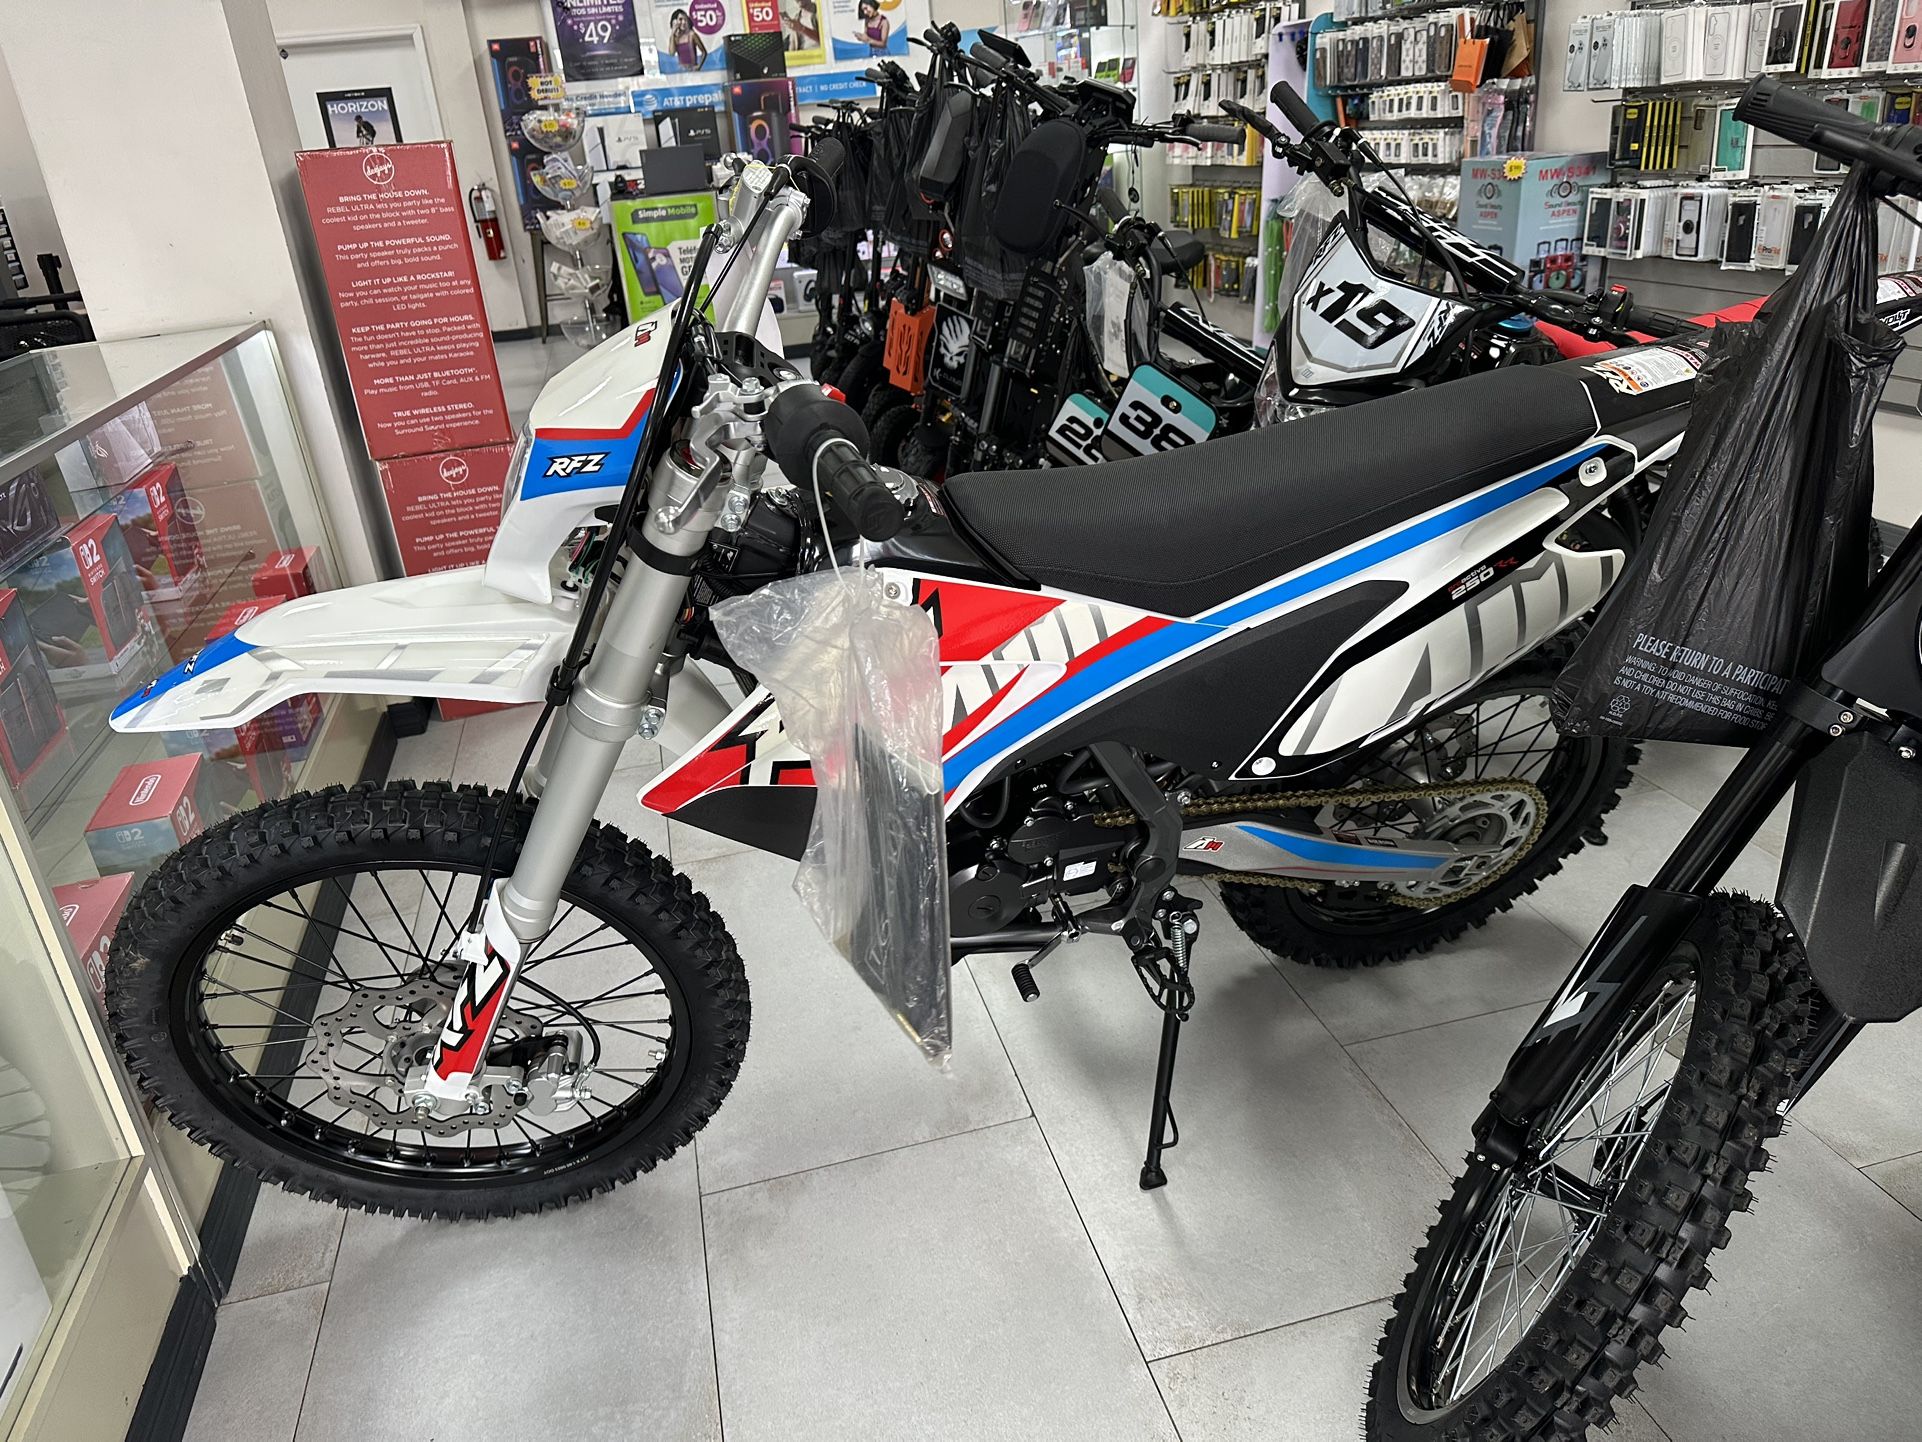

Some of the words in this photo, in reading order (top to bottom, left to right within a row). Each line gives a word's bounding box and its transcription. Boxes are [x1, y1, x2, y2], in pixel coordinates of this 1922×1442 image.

[692, 10, 717, 26] $50
[750, 8, 773, 21] $50
[579, 21, 611, 44] $49
[830, 83, 848, 91] CREDIT
[327, 100, 388, 114] HORIZON
[663, 95, 685, 106] AT&T
[378, 191, 403, 200] HOUSE
[638, 208, 666, 219] Simple
[667, 206, 696, 215] Mobile
[1551, 208, 1577, 218] ASPEN
[402, 218, 428, 226] tweeter.
[385, 237, 424, 246] POWERFUL
[426, 234, 451, 242] SOUND.
[392, 275, 408, 283] LIKE
[416, 271, 454, 280] ROCKSTAR!
[449, 314, 474, 322] HOURS.
[374, 377, 393, 385] MORE
[412, 406, 445, 415] WIRELESS
[447, 402, 473, 410] STEREO.
[544, 452, 610, 478] RFZ
[1451, 567, 1494, 600] 250
[1632, 633, 1673, 658] PLEASE
[1669, 646, 1710, 670] RTURN
[1708, 656, 1724, 674] TO
[1721, 662, 1733, 678] A
[1658, 665, 1668, 676] TO
[1685, 674, 1712, 689] DANGER
[1712, 682, 1722, 692] OF
[1619, 666, 1635, 678] AND
[1666, 680, 1677, 691] DO
[1692, 690, 1706, 700] USE
[1706, 693, 1722, 705] THIS
[1721, 698, 1737, 709] BAG
[1735, 702, 1745, 712] IN
[1614, 676, 1622, 685] IS
[1621, 678, 1637, 689] NOT
[1634, 683, 1641, 691] A
[1667, 694, 1719, 716] RECOMMENDED
[1717, 709, 1732, 721] FOR
[1731, 713, 1750, 726] FOOD
